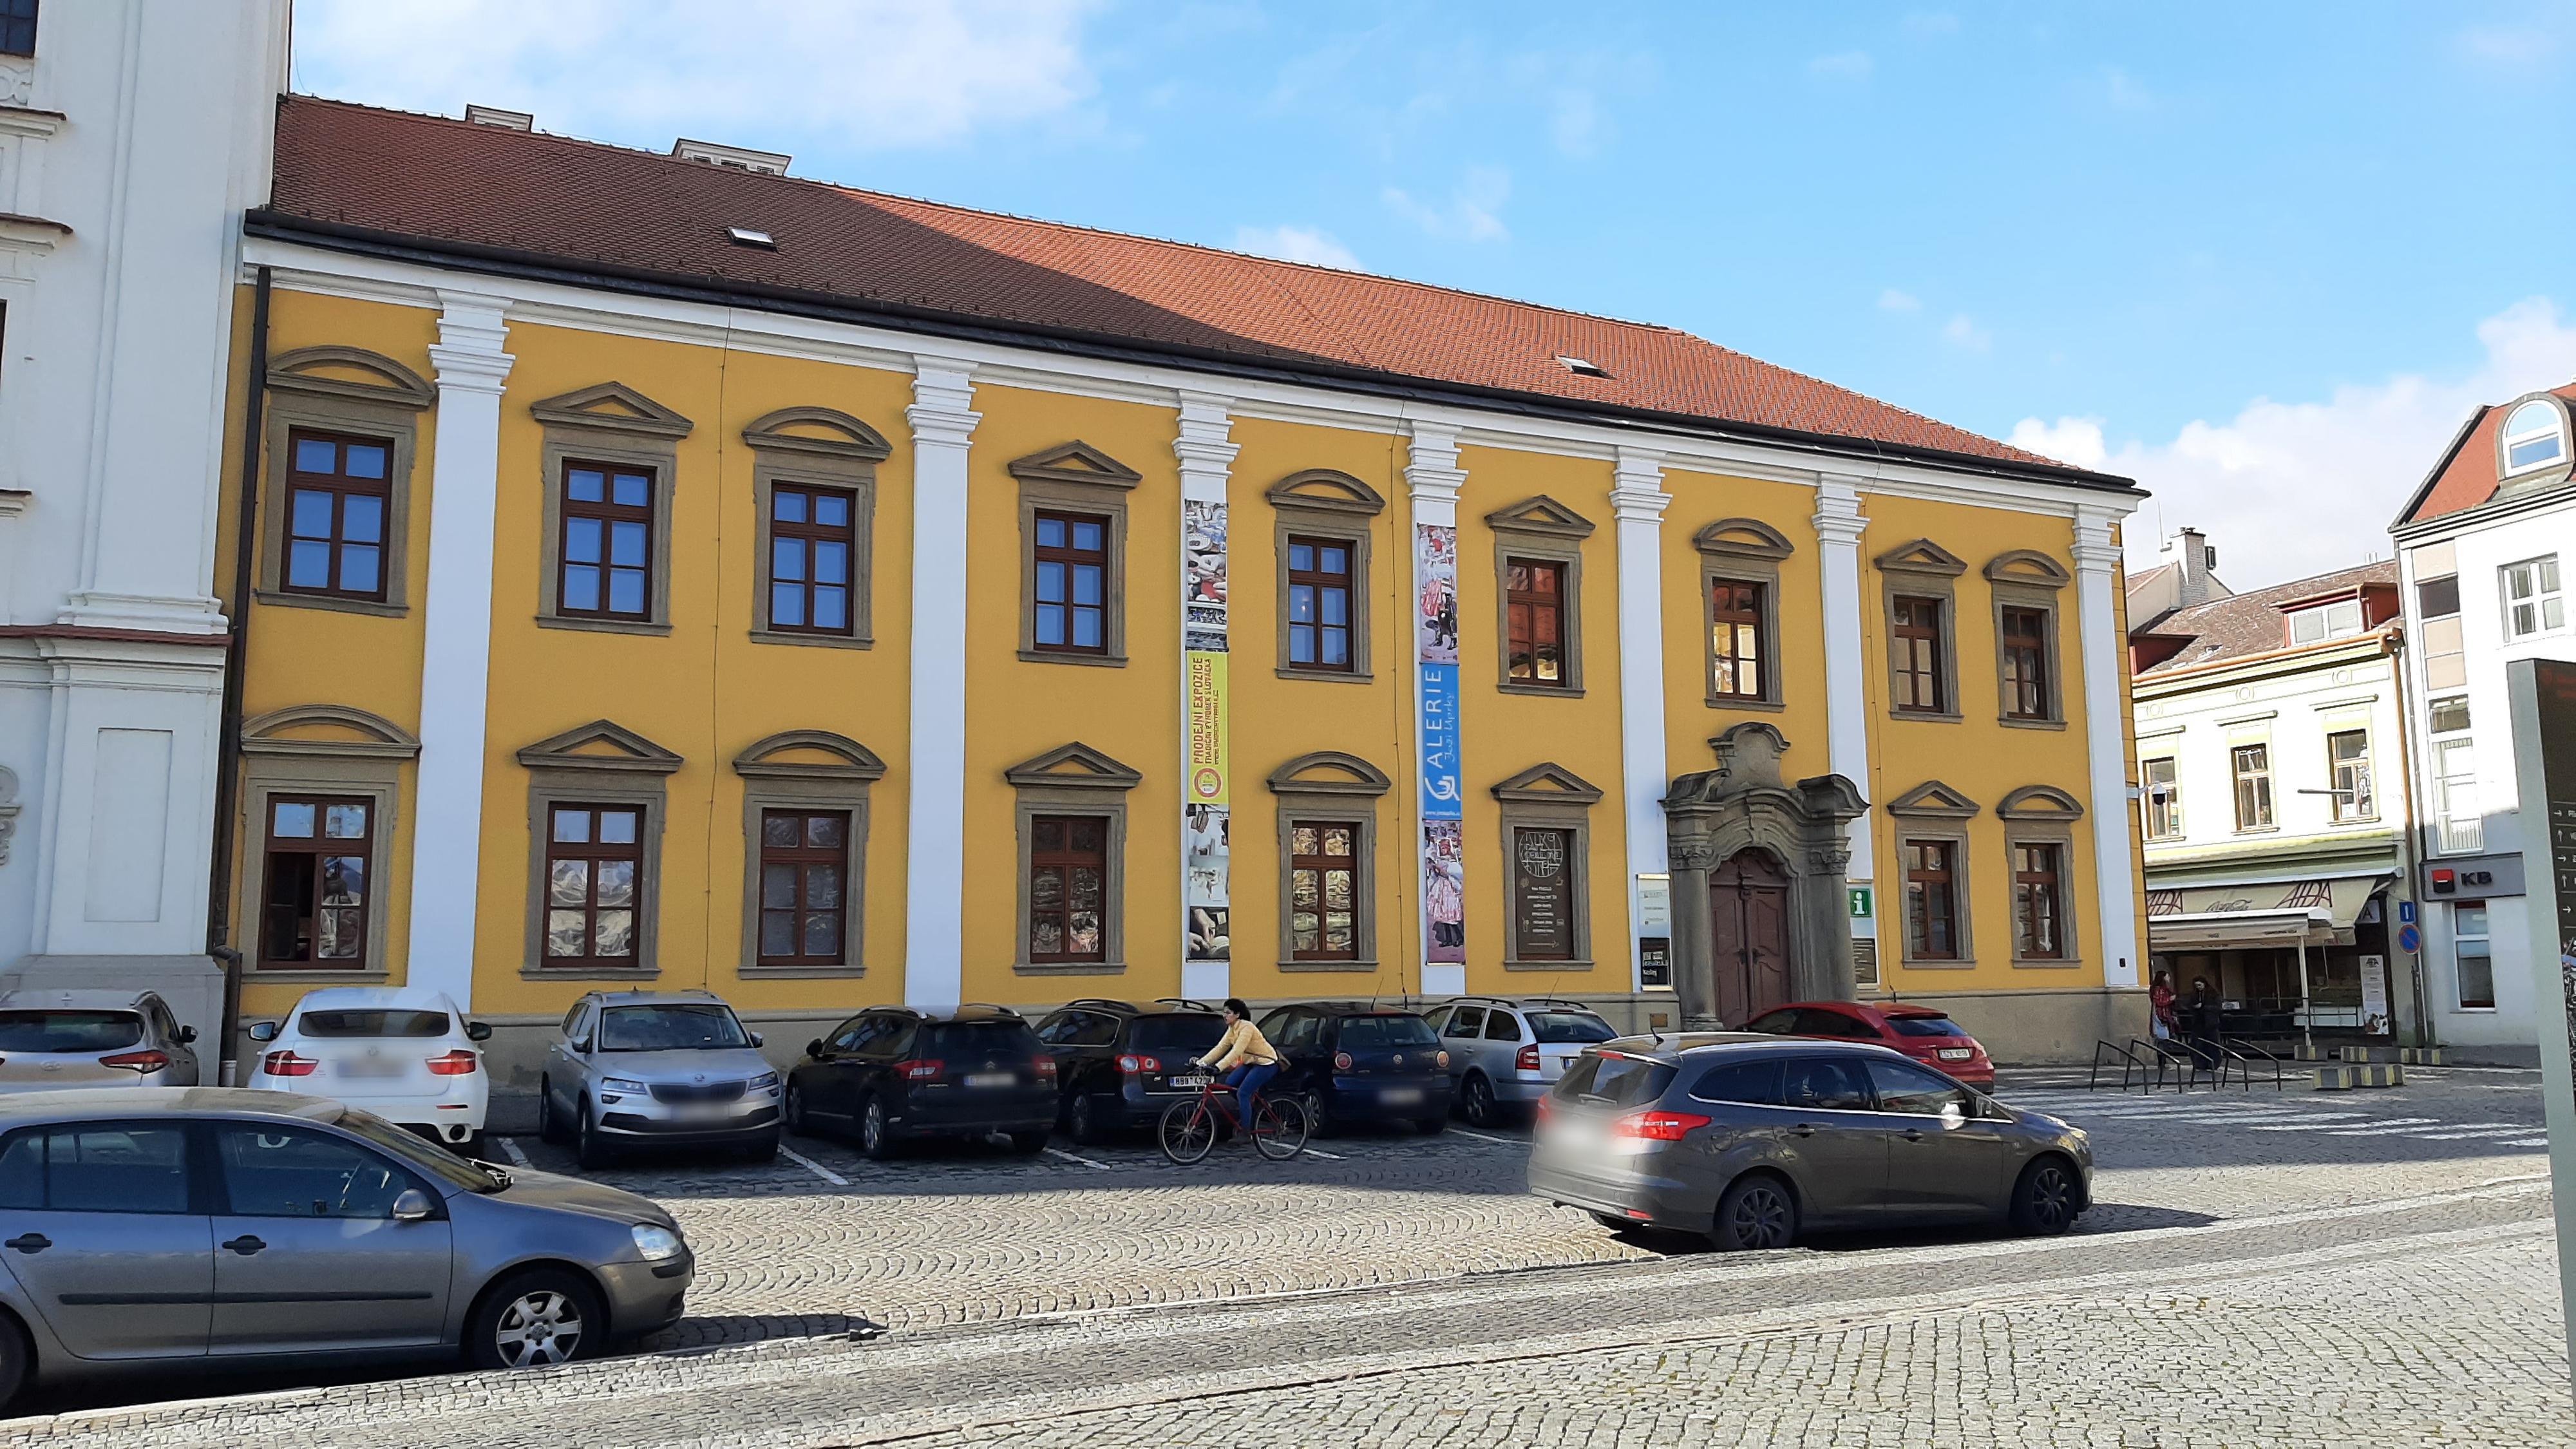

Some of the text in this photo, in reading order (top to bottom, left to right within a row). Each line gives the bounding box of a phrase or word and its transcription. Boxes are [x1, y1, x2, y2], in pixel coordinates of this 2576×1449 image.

[1193, 658, 1203, 708] EXPOZICE
[2461, 871, 2492, 886] KB
[2274, 880, 2333, 909] AIDA
